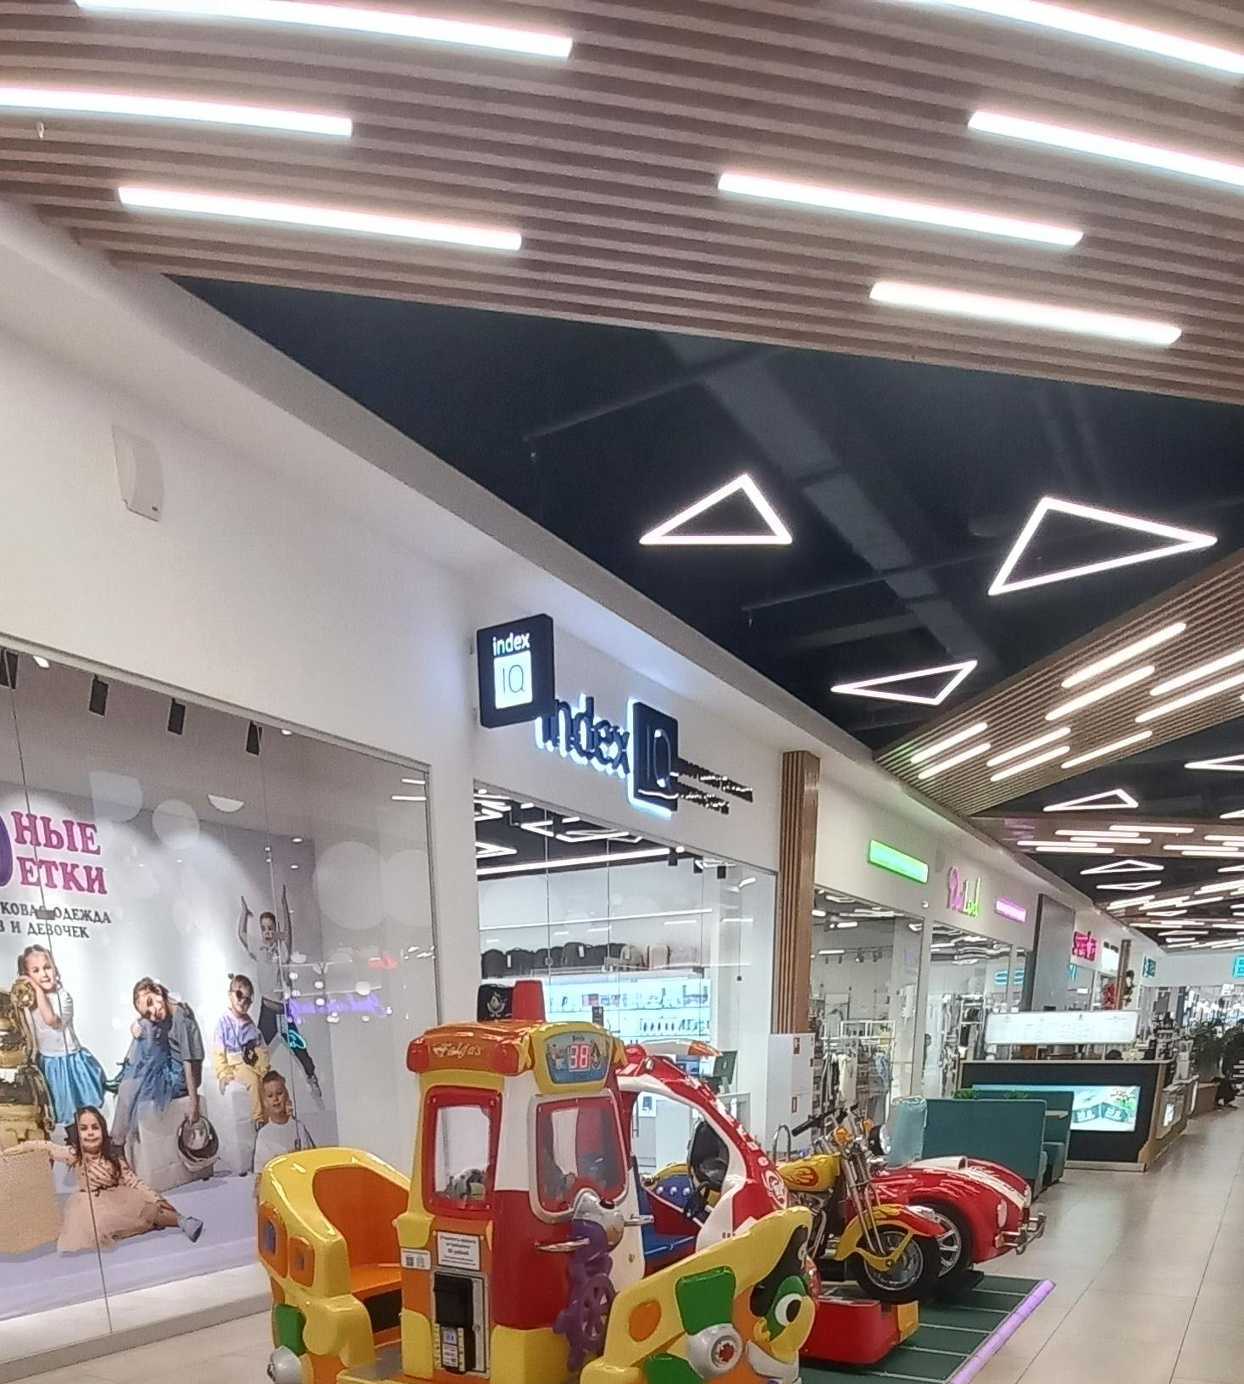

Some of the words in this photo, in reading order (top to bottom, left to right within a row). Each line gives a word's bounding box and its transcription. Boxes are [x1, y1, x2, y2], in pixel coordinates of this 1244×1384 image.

[492, 632, 531, 657] index
[502, 664, 525, 695] IQ
[11, 811, 101, 855] НЫЕ
[16, 856, 108, 894] ЕТКИ
[0, 901, 47, 917] КОВА
[54, 906, 112, 924] ОДЕЖДА
[10, 920, 21, 934] И
[27, 922, 90, 938] ДЕВОЧЕК
[569, 1044, 589, 1068] 38
